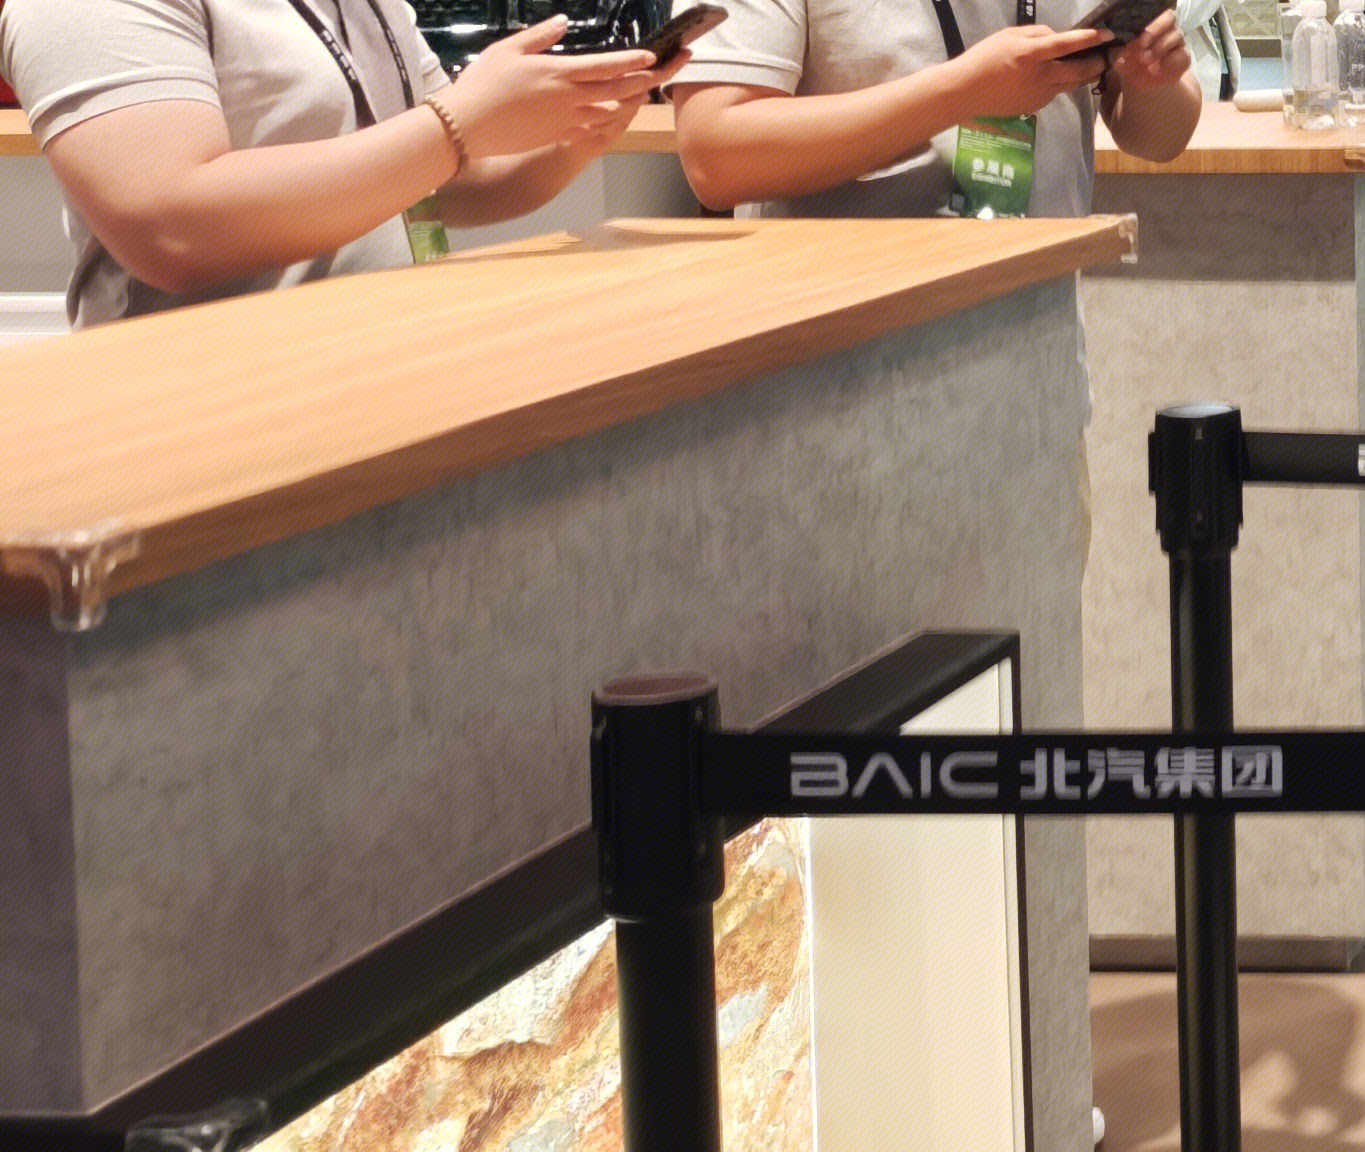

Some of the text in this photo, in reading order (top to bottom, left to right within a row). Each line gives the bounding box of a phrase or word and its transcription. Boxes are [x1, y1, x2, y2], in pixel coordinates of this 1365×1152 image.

[790, 744, 1284, 800] BAIC 北汽集团
